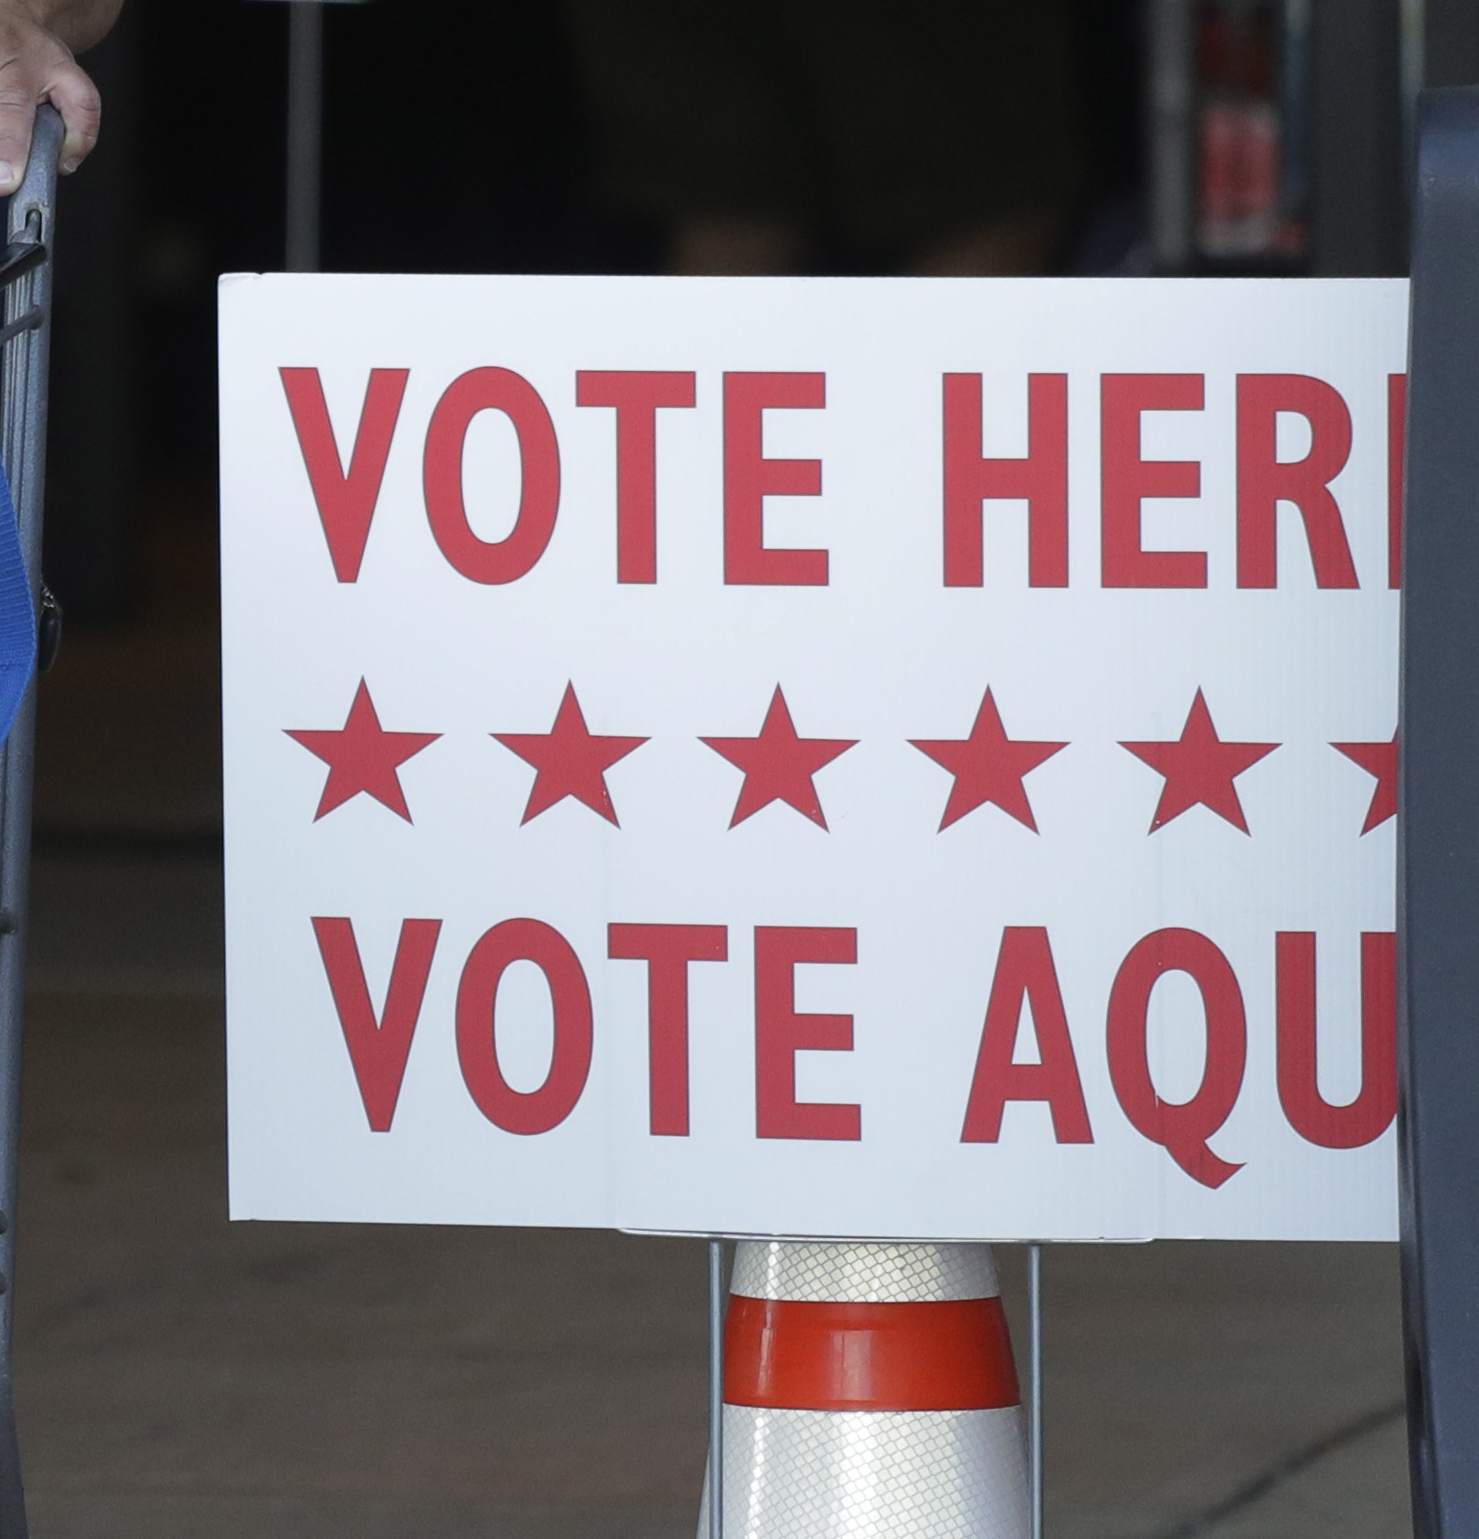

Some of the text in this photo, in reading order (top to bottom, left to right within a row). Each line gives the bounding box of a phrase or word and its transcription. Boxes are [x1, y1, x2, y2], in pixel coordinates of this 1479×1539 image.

[278, 365, 1407, 590] VOTE HER
[310, 916, 1398, 1191] VOTE AQU
